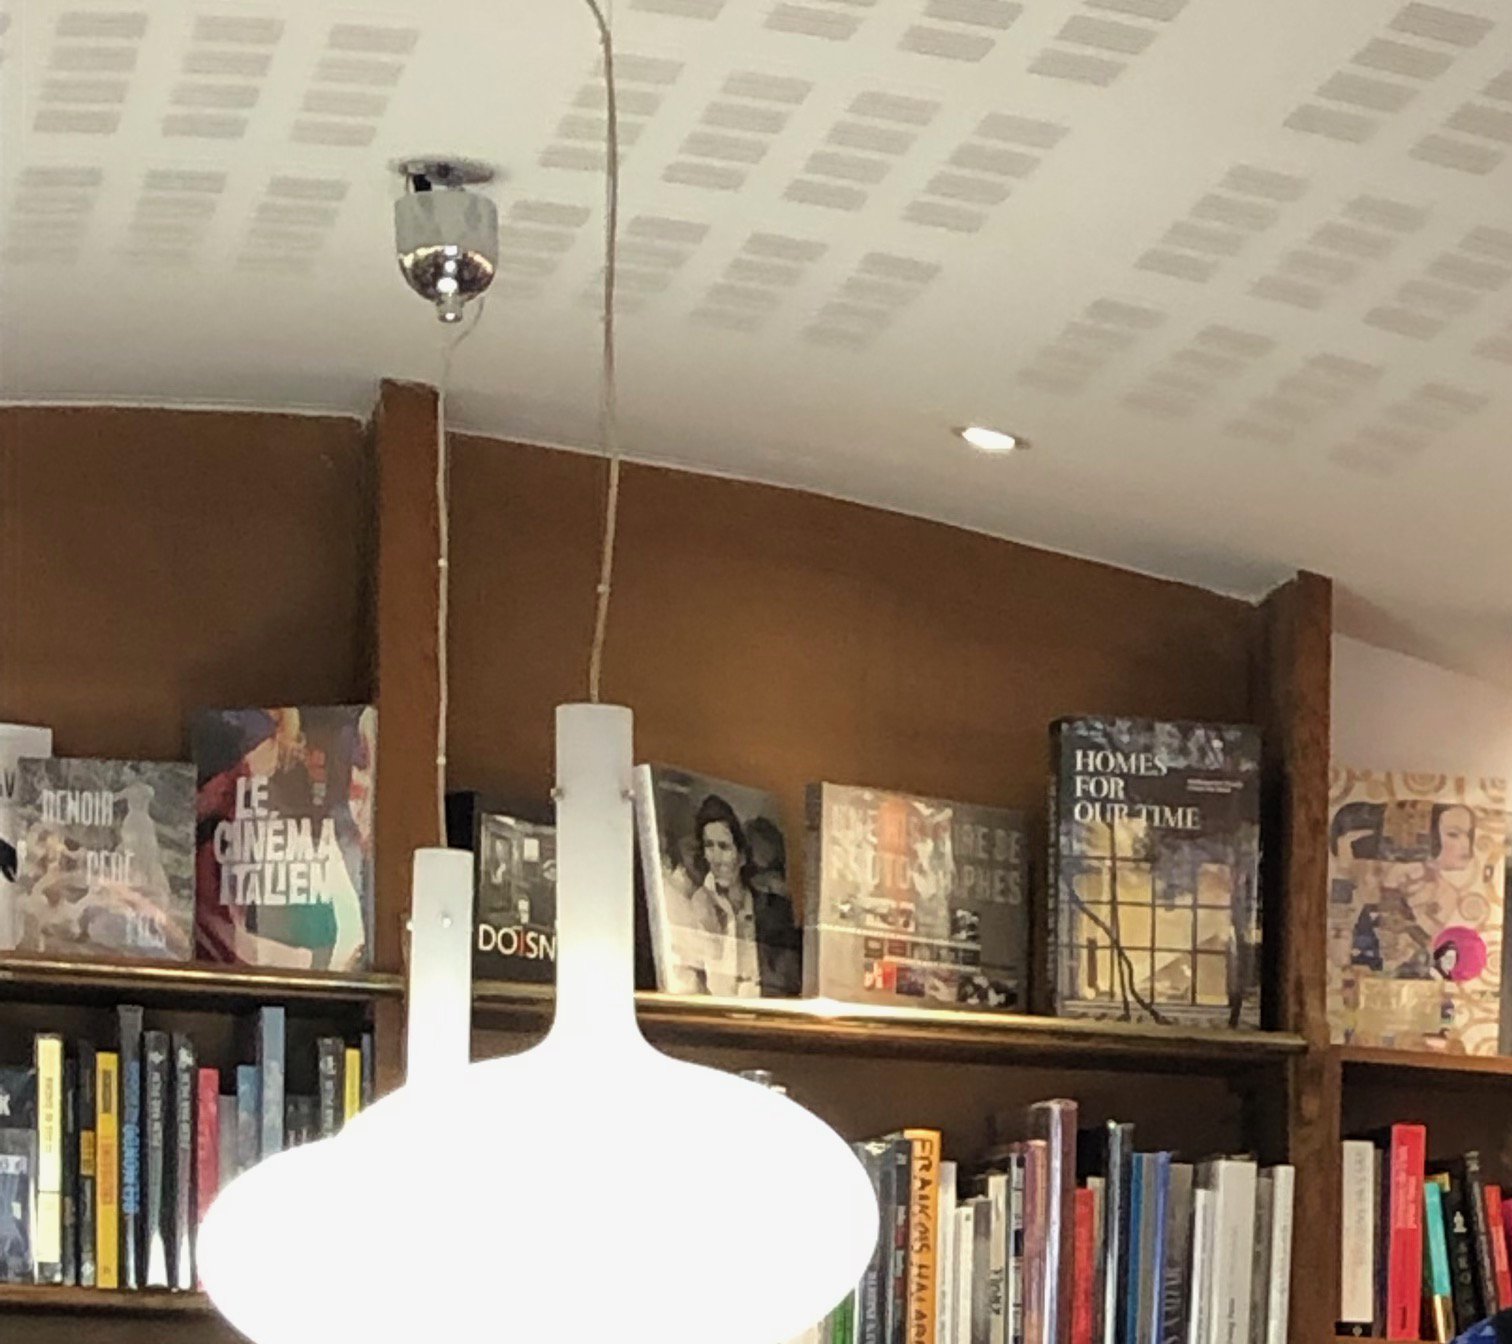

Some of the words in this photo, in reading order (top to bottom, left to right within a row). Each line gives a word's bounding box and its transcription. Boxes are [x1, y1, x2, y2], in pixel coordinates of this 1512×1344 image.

[1074, 749, 1168, 777] HOMES
[235, 775, 270, 820] LE
[1074, 774, 1126, 799] FOR
[1073, 800, 1129, 825] OUR
[1136, 804, 1201, 830] TIME
[213, 811, 337, 864] CINÉMA
[218, 862, 335, 906] ITALIEN
